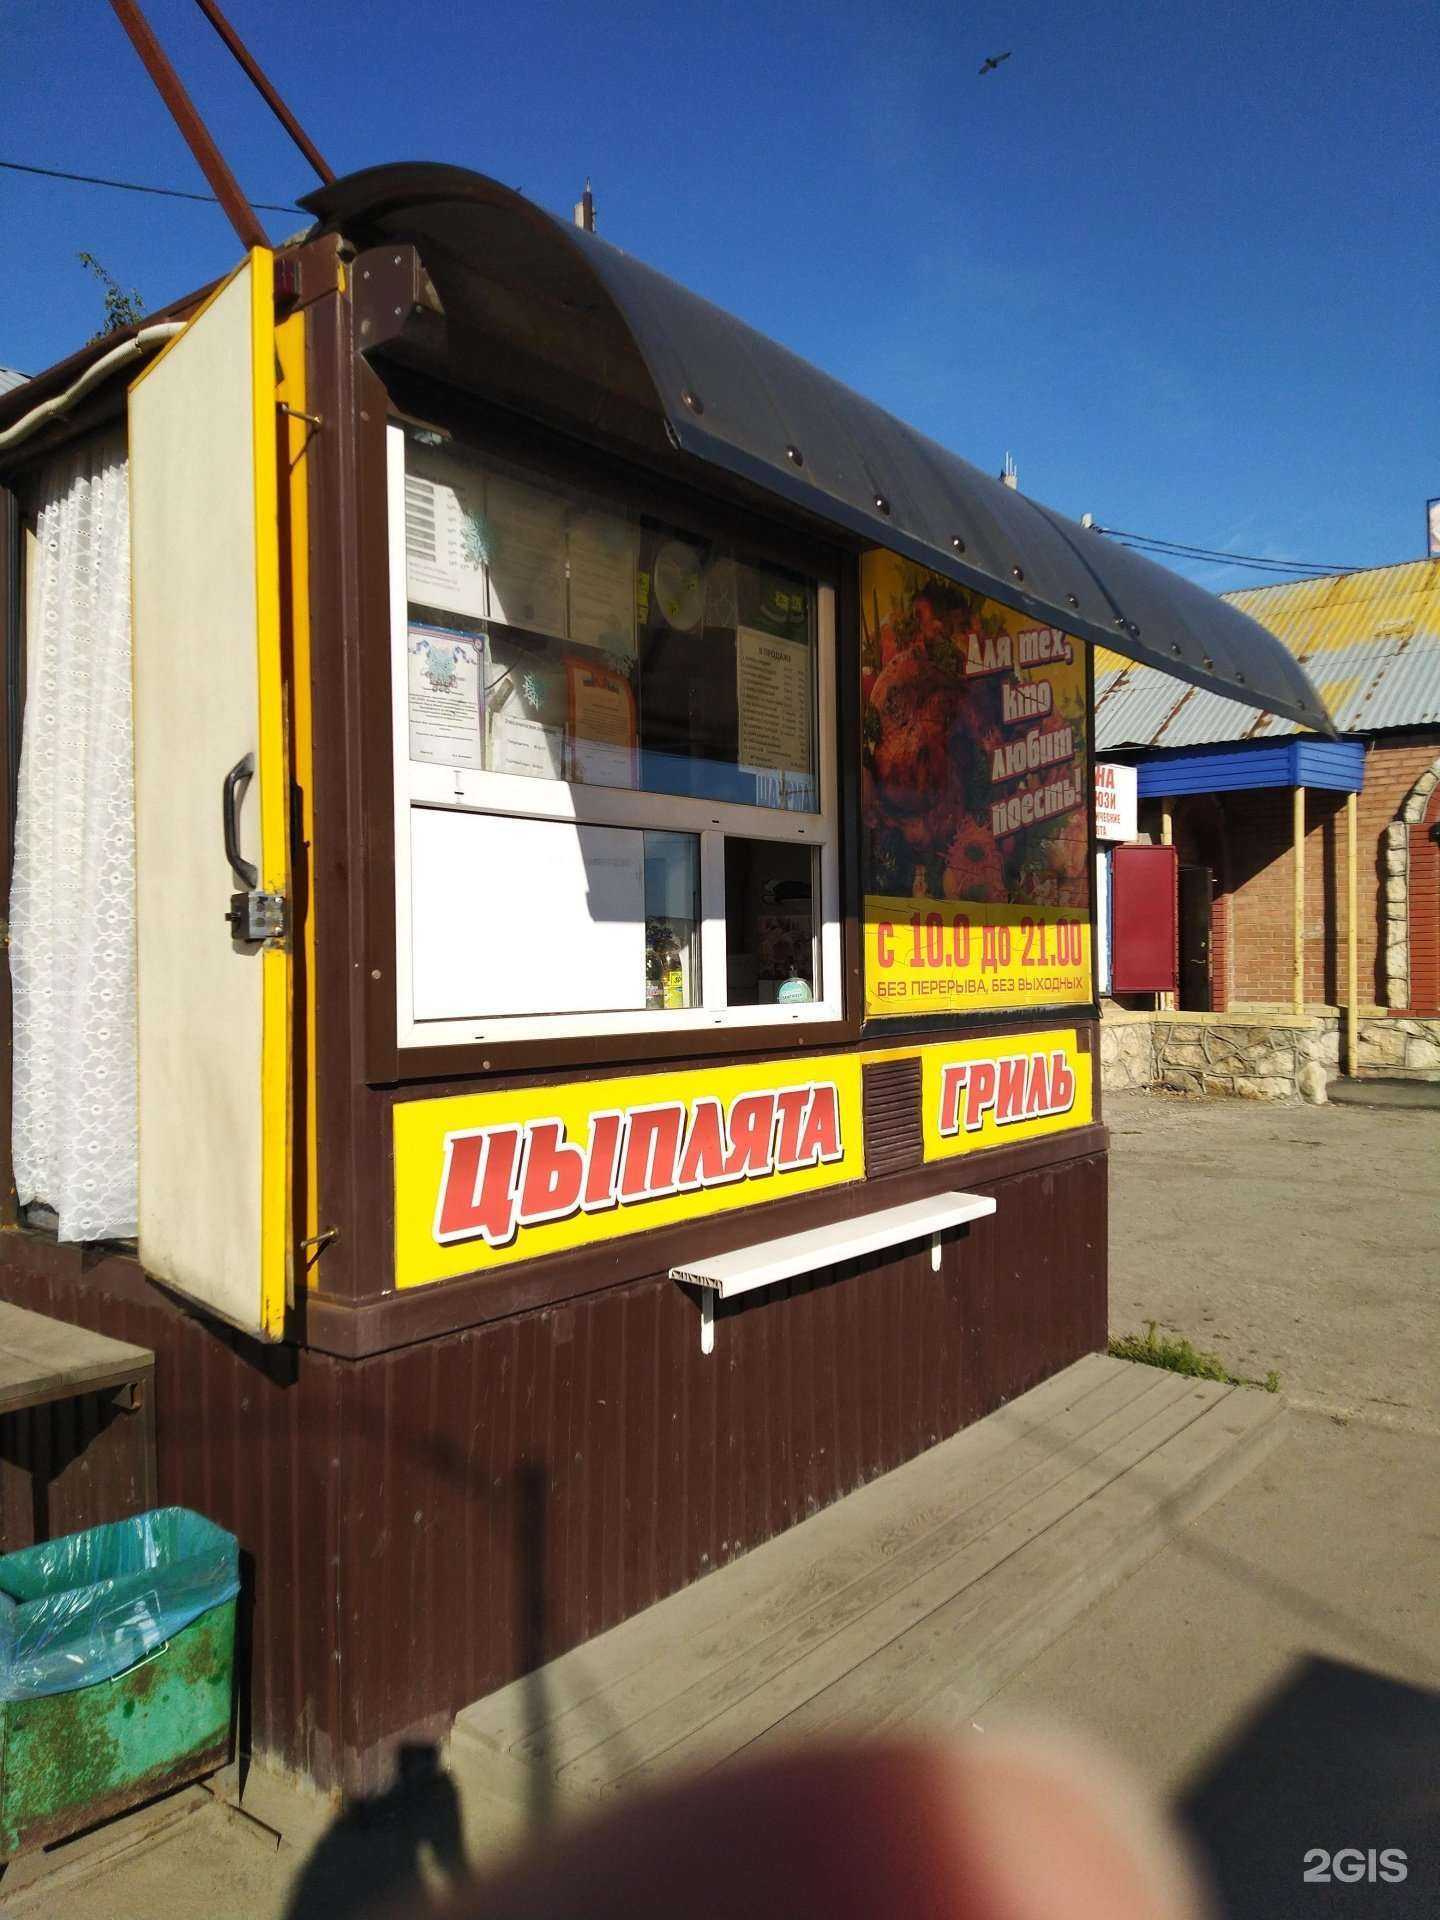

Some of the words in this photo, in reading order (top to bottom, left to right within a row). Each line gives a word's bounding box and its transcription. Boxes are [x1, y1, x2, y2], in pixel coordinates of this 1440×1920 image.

[964, 632, 1013, 676] Для
[1018, 628, 1073, 666] тех,
[991, 727, 1073, 782] любит
[991, 766, 1083, 837] поесть!
[909, 911, 971, 968] 10.0
[981, 923, 1012, 974] до
[1020, 916, 1083, 968] 21.00
[877, 981, 907, 997] БЕЗ
[911, 978, 989, 996] ПЕРЕРЫВА,
[992, 978, 1016, 993] БЕЗ
[1018, 975, 1084, 994] ВЫХОДНЫХ
[434, 1082, 844, 1243] ЦЫПЛЯТА
[938, 1050, 1076, 1136] ГРИЛЬ
